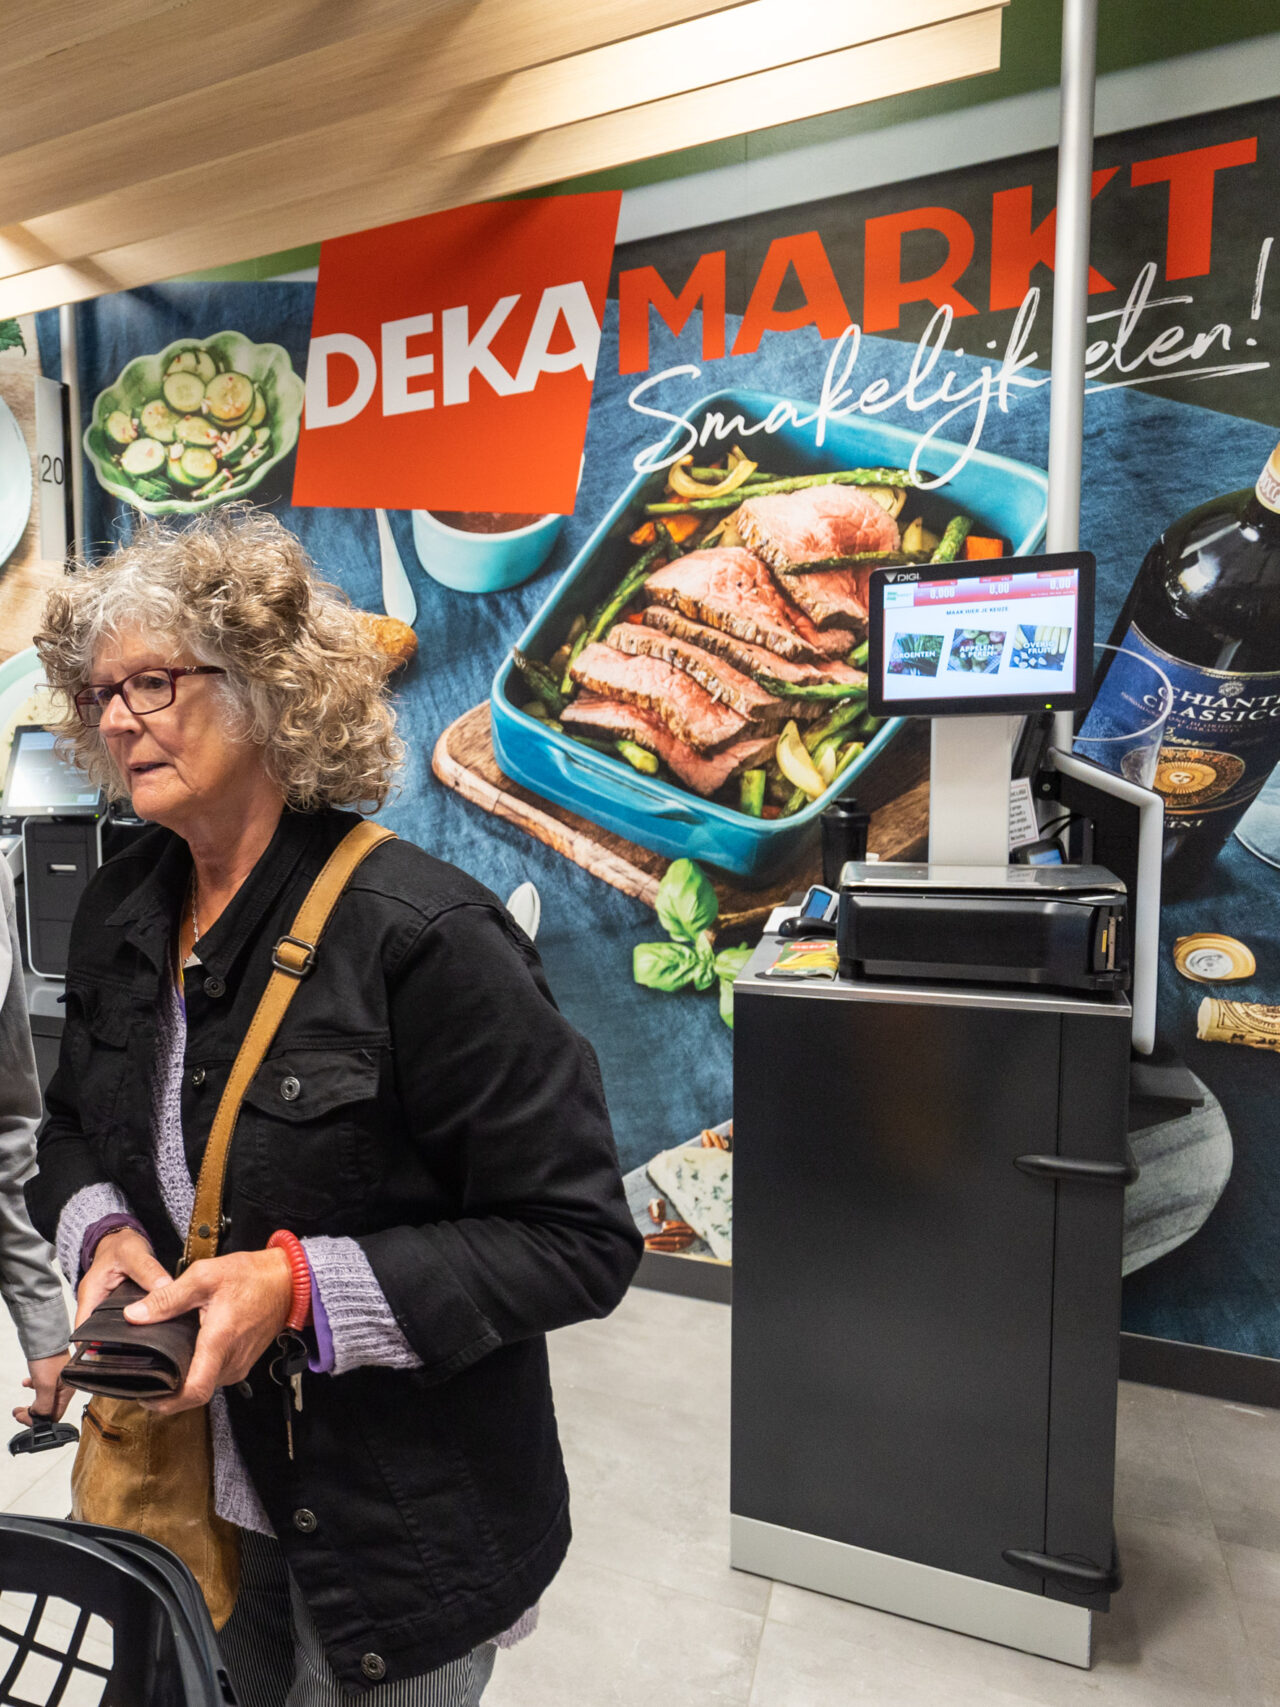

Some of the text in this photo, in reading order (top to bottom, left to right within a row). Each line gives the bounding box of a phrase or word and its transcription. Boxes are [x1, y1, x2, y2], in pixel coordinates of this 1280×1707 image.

[305, 137, 1258, 430] DEKA MARKT
[627, 286, 1052, 491] Smakelijk
[41, 454, 64, 485] 20
[897, 573, 920, 582] DIGI
[1158, 686, 1280, 709] CHIANT
